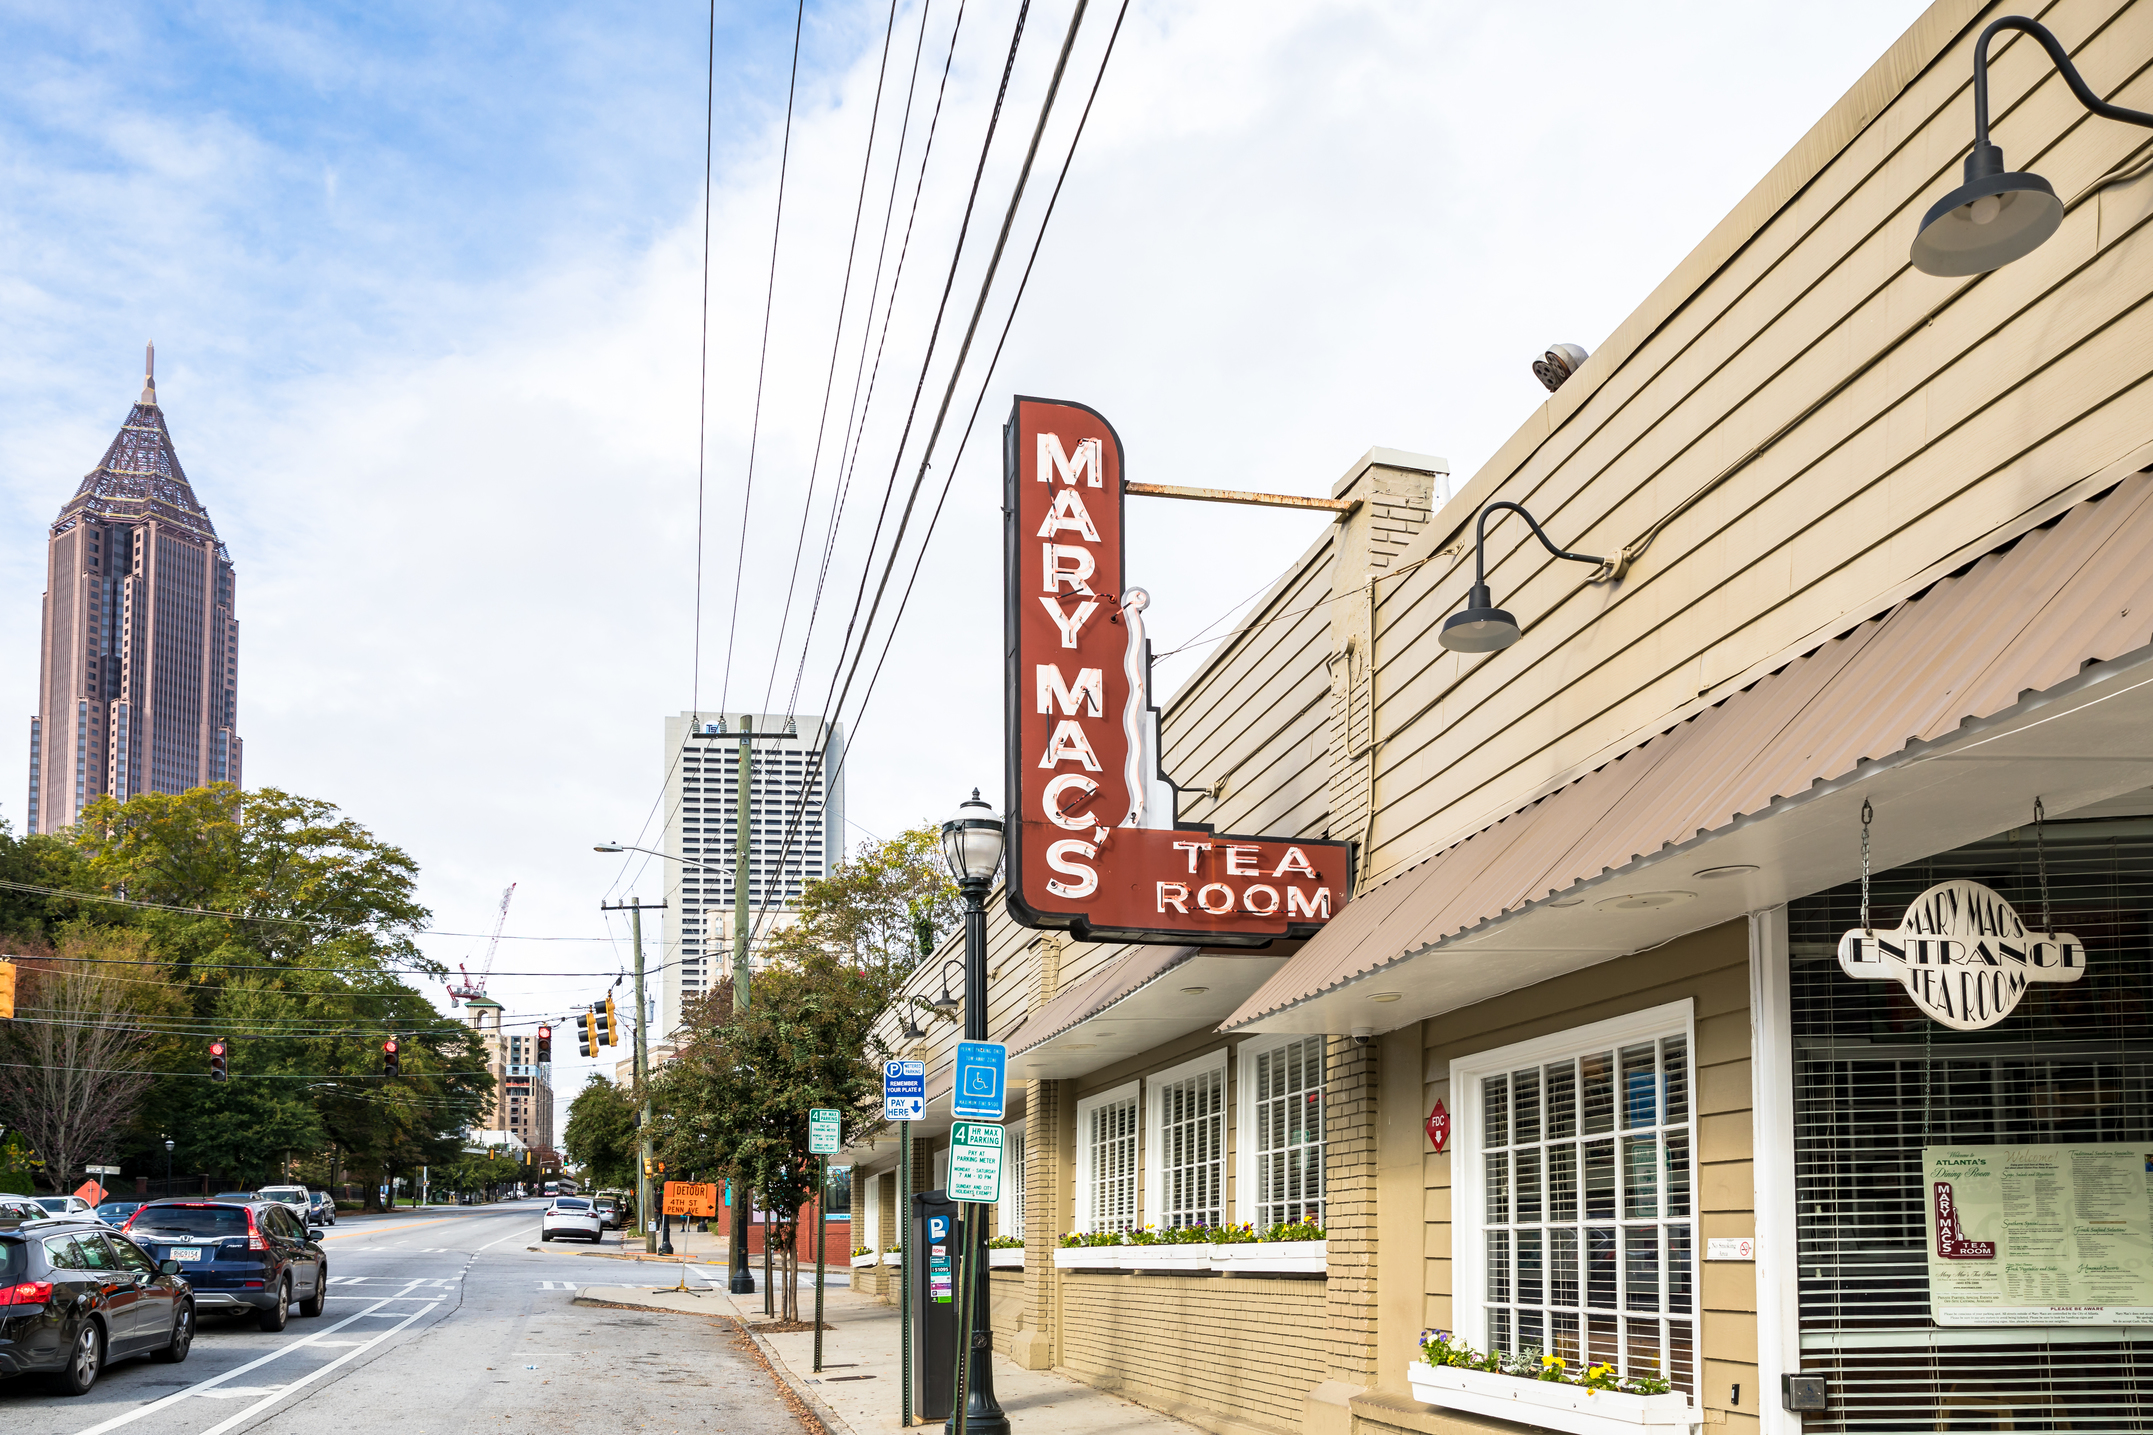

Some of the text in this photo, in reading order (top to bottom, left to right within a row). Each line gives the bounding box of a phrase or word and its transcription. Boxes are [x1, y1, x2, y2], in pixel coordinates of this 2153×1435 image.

[1036, 432, 1103, 649] MARY
[1173, 840, 1318, 879] TEA
[1156, 881, 1331, 919] ROOM
[1904, 886, 2024, 939] MARY MAC'S
[1848, 937, 2085, 968] ENTRANCE
[1907, 967, 2027, 1023] TEA ROOM
[890, 1064, 899, 1075] P
[812, 1111, 818, 1120] 4
[1432, 1115, 1444, 1127] FDC
[955, 1126, 966, 1142] 4
[972, 1127, 998, 1137] HR MAX
[970, 1136, 999, 1145] PARKING
[2004, 1149, 2058, 1163] Welcome!
[1930, 1167, 1990, 1180] Dining Room
[677, 1186, 705, 1196] DETOUR
[1938, 1185, 1950, 1217] MARY
[1940, 1219, 1954, 1252] MAC'S
